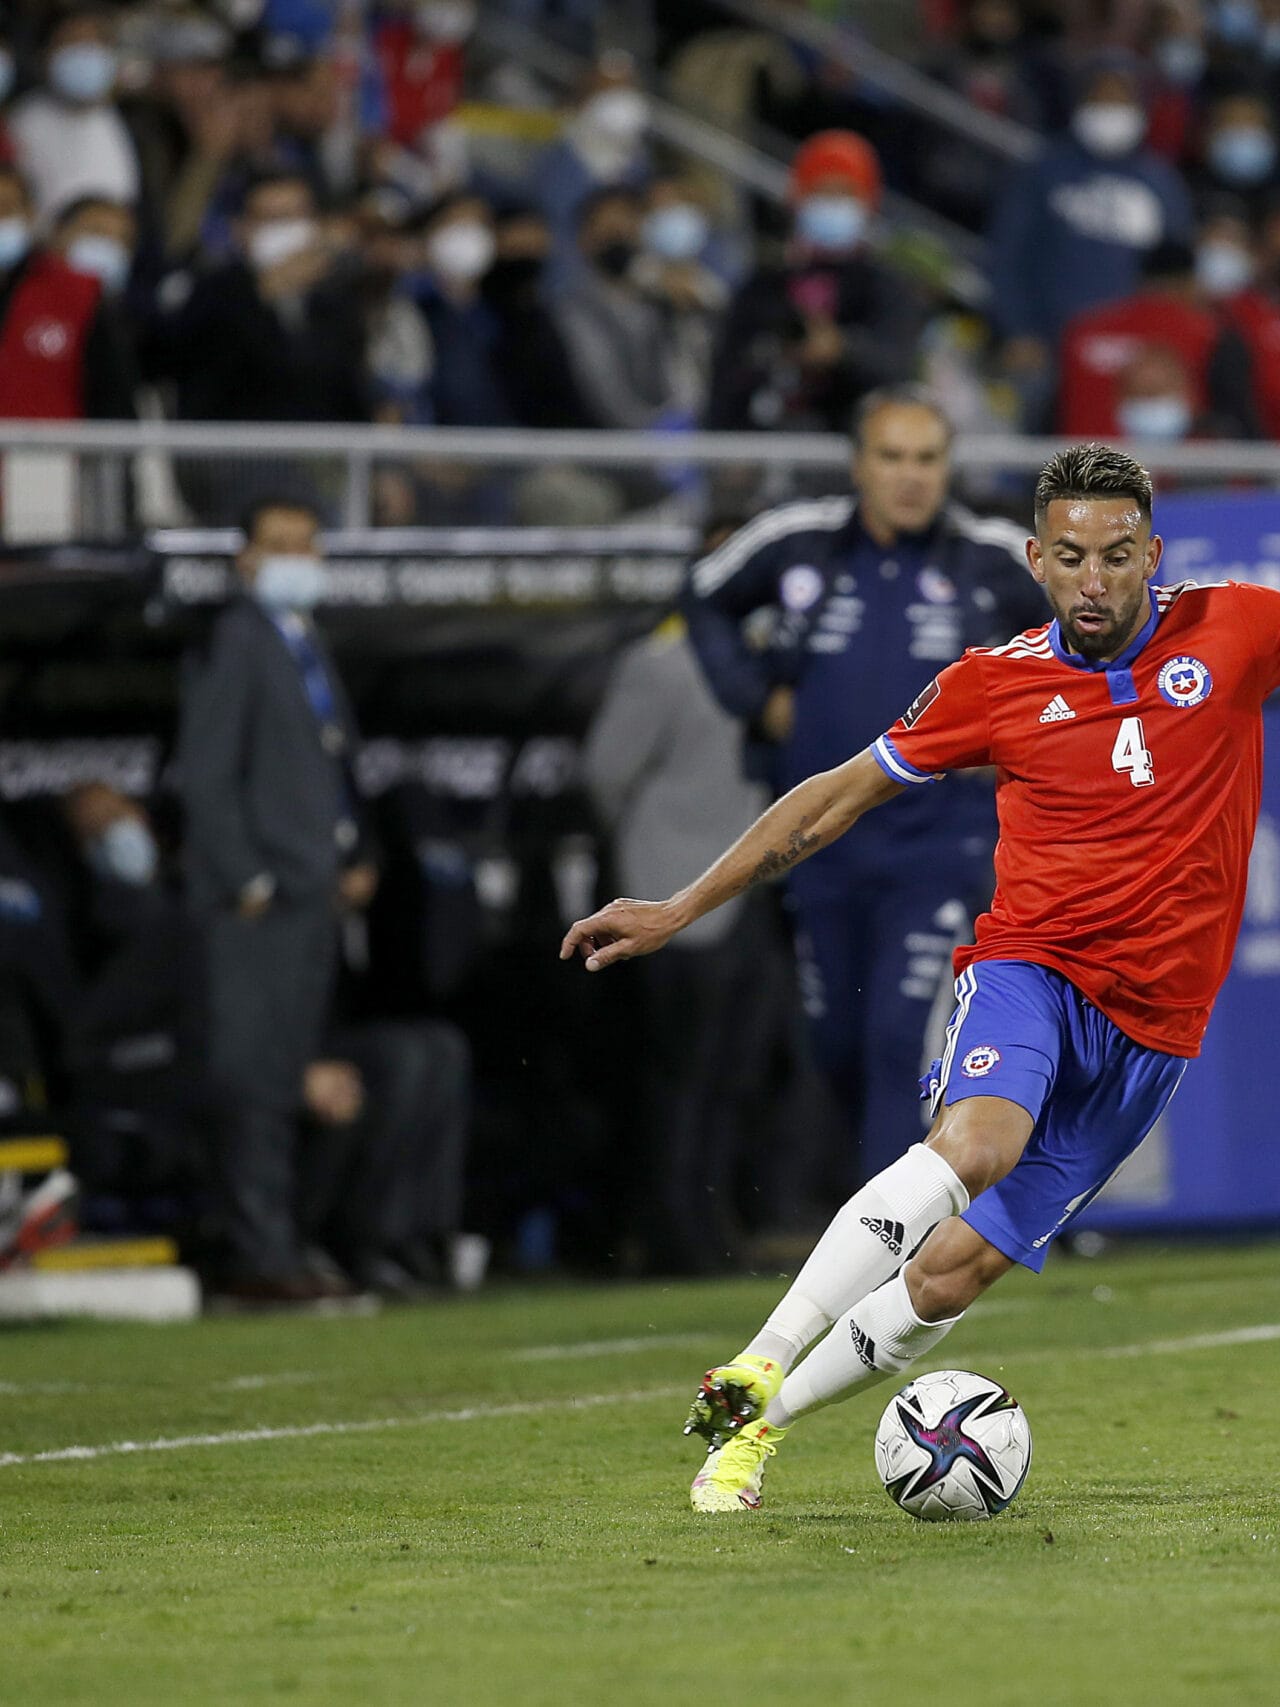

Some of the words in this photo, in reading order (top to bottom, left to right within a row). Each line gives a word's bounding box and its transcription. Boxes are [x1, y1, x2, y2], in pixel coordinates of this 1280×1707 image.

[1039, 708, 1076, 724] adidas
[1111, 716, 1155, 788] 4
[860, 1217, 902, 1256] adidas
[850, 1319, 879, 1371] adidas
